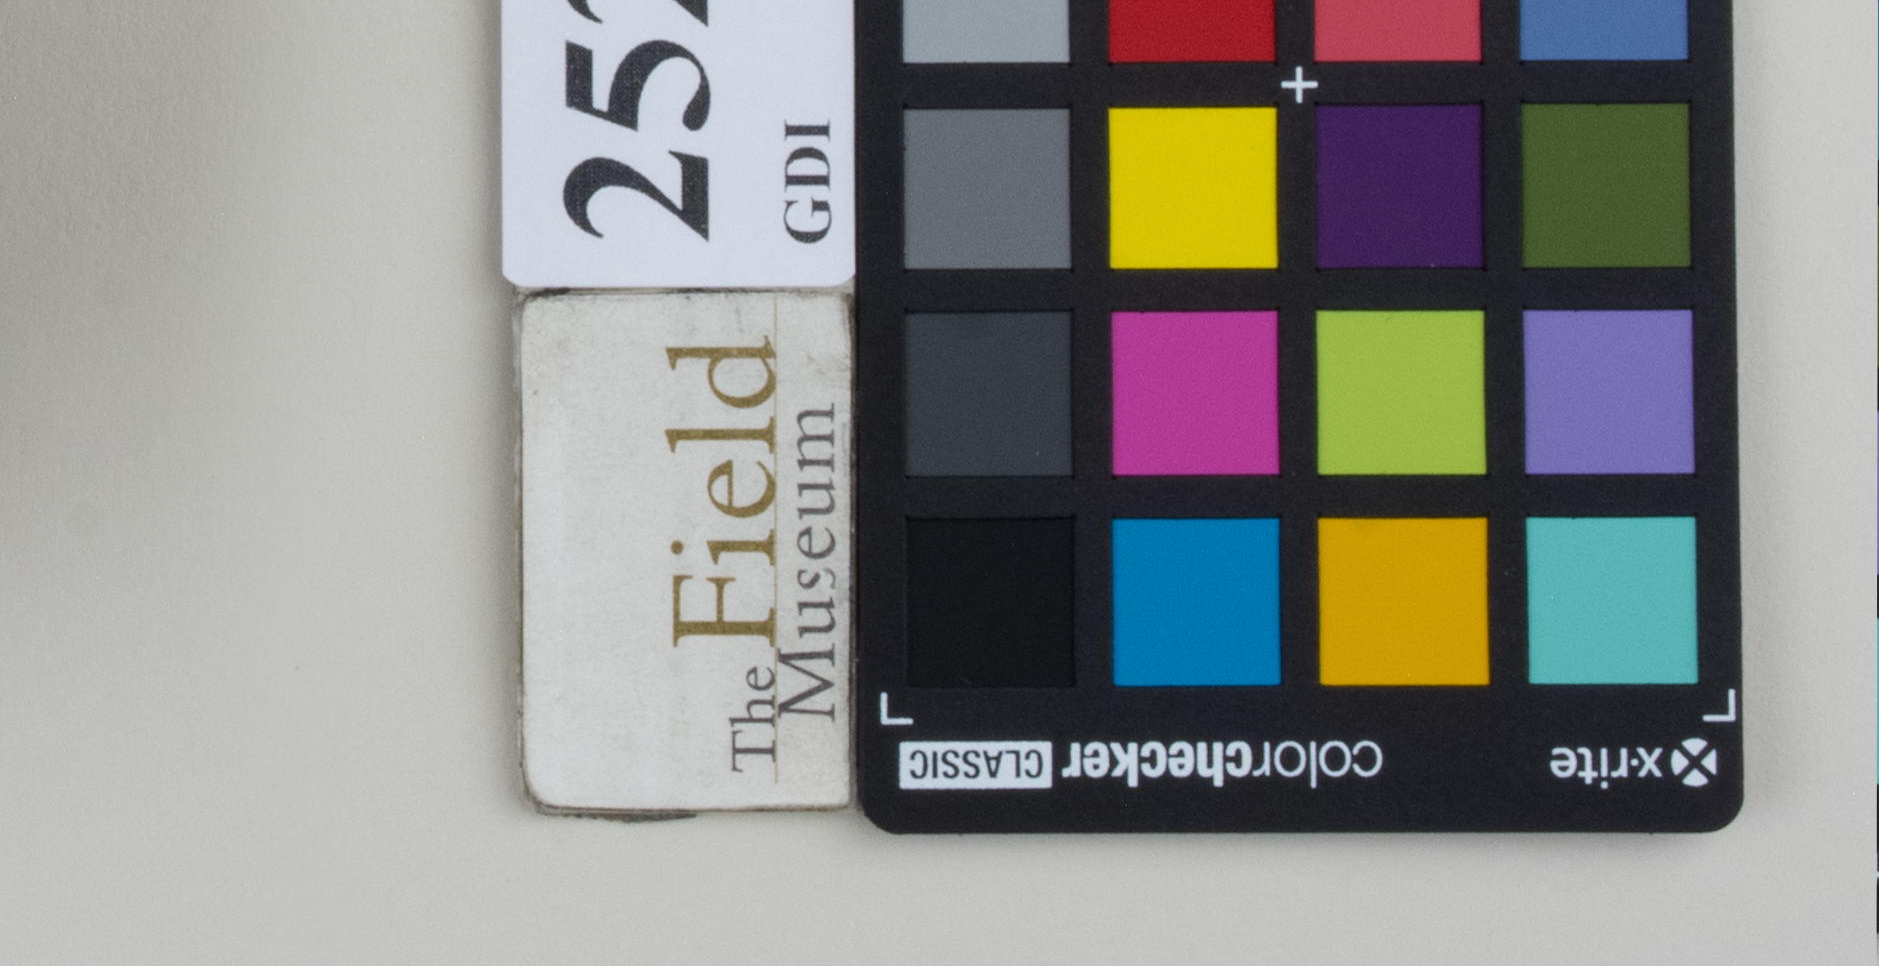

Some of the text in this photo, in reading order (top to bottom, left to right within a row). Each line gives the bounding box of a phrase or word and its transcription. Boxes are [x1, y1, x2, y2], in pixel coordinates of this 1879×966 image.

[782, 119, 832, 244] GDI
[664, 334, 777, 773] The Field
[777, 402, 837, 723] Museum
[908, 740, 1384, 789] colorchecker CLASSIC
